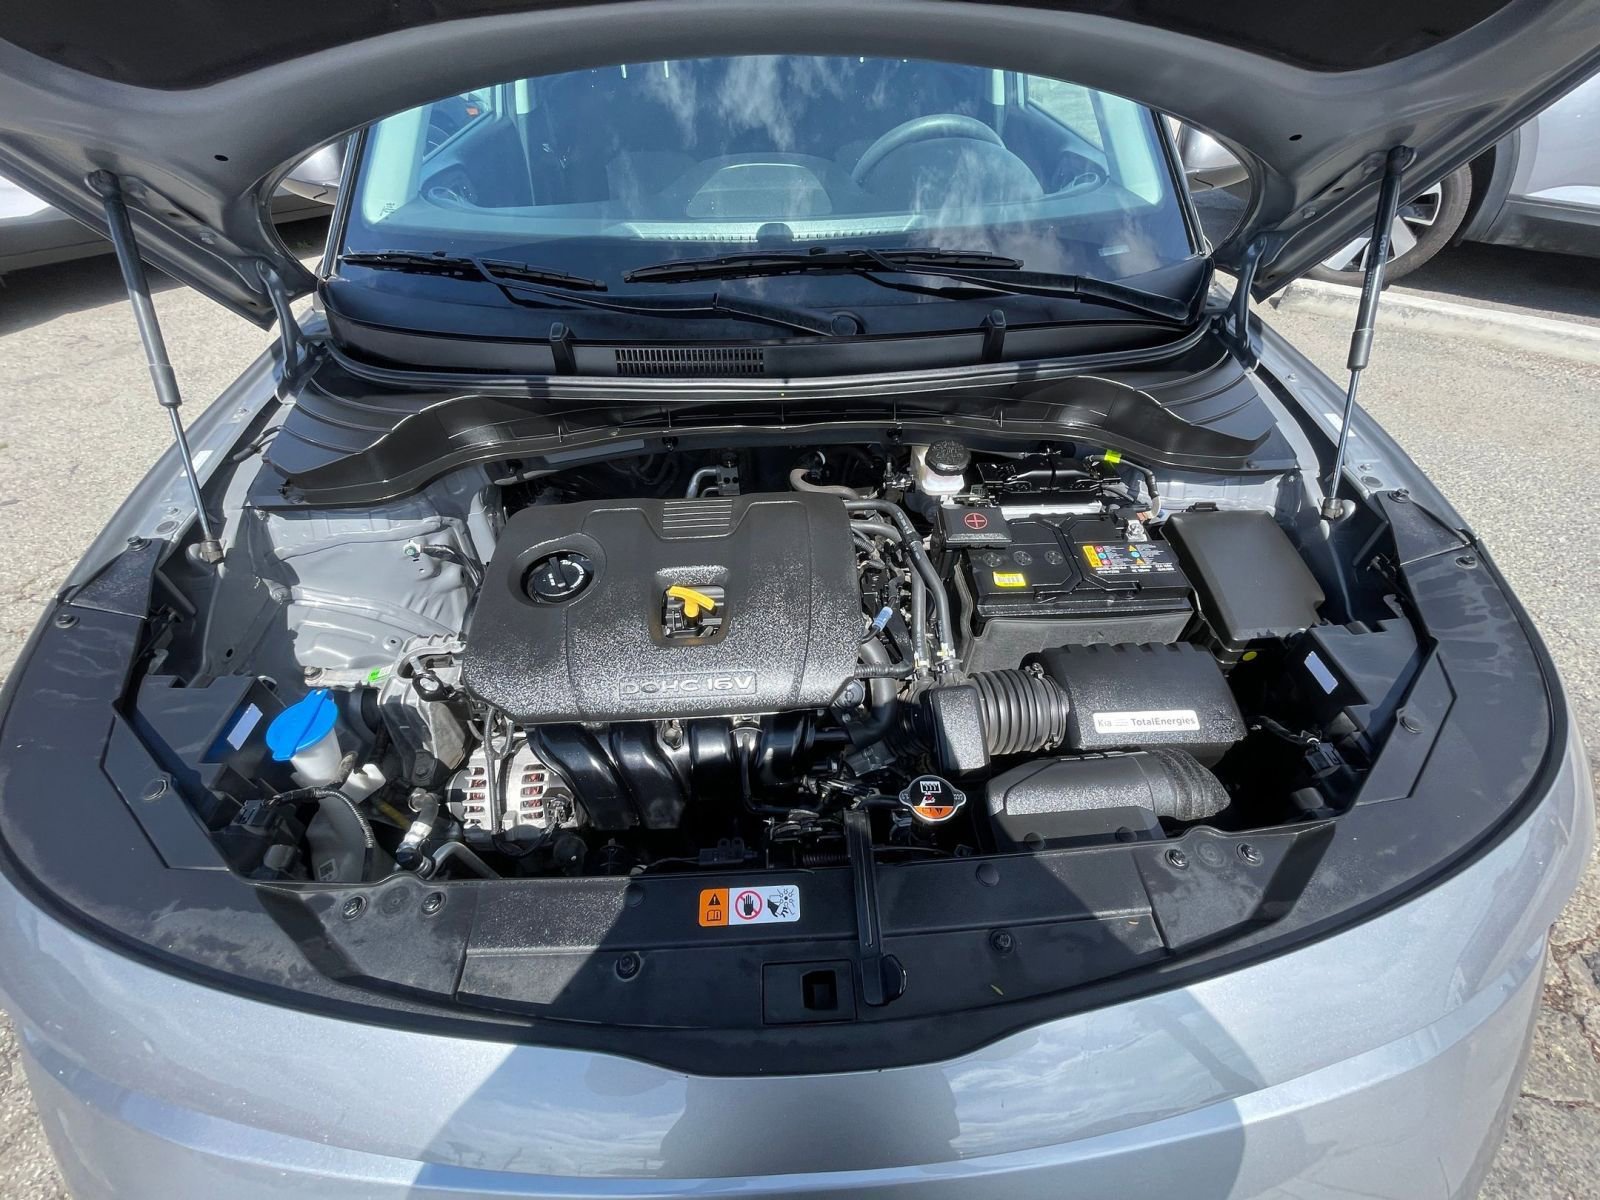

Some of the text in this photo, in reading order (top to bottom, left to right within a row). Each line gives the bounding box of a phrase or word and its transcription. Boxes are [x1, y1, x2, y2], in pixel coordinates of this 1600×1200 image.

[622, 676, 753, 695] DOHC 16V
[1098, 717, 1196, 728] Kia TotalEnergies
